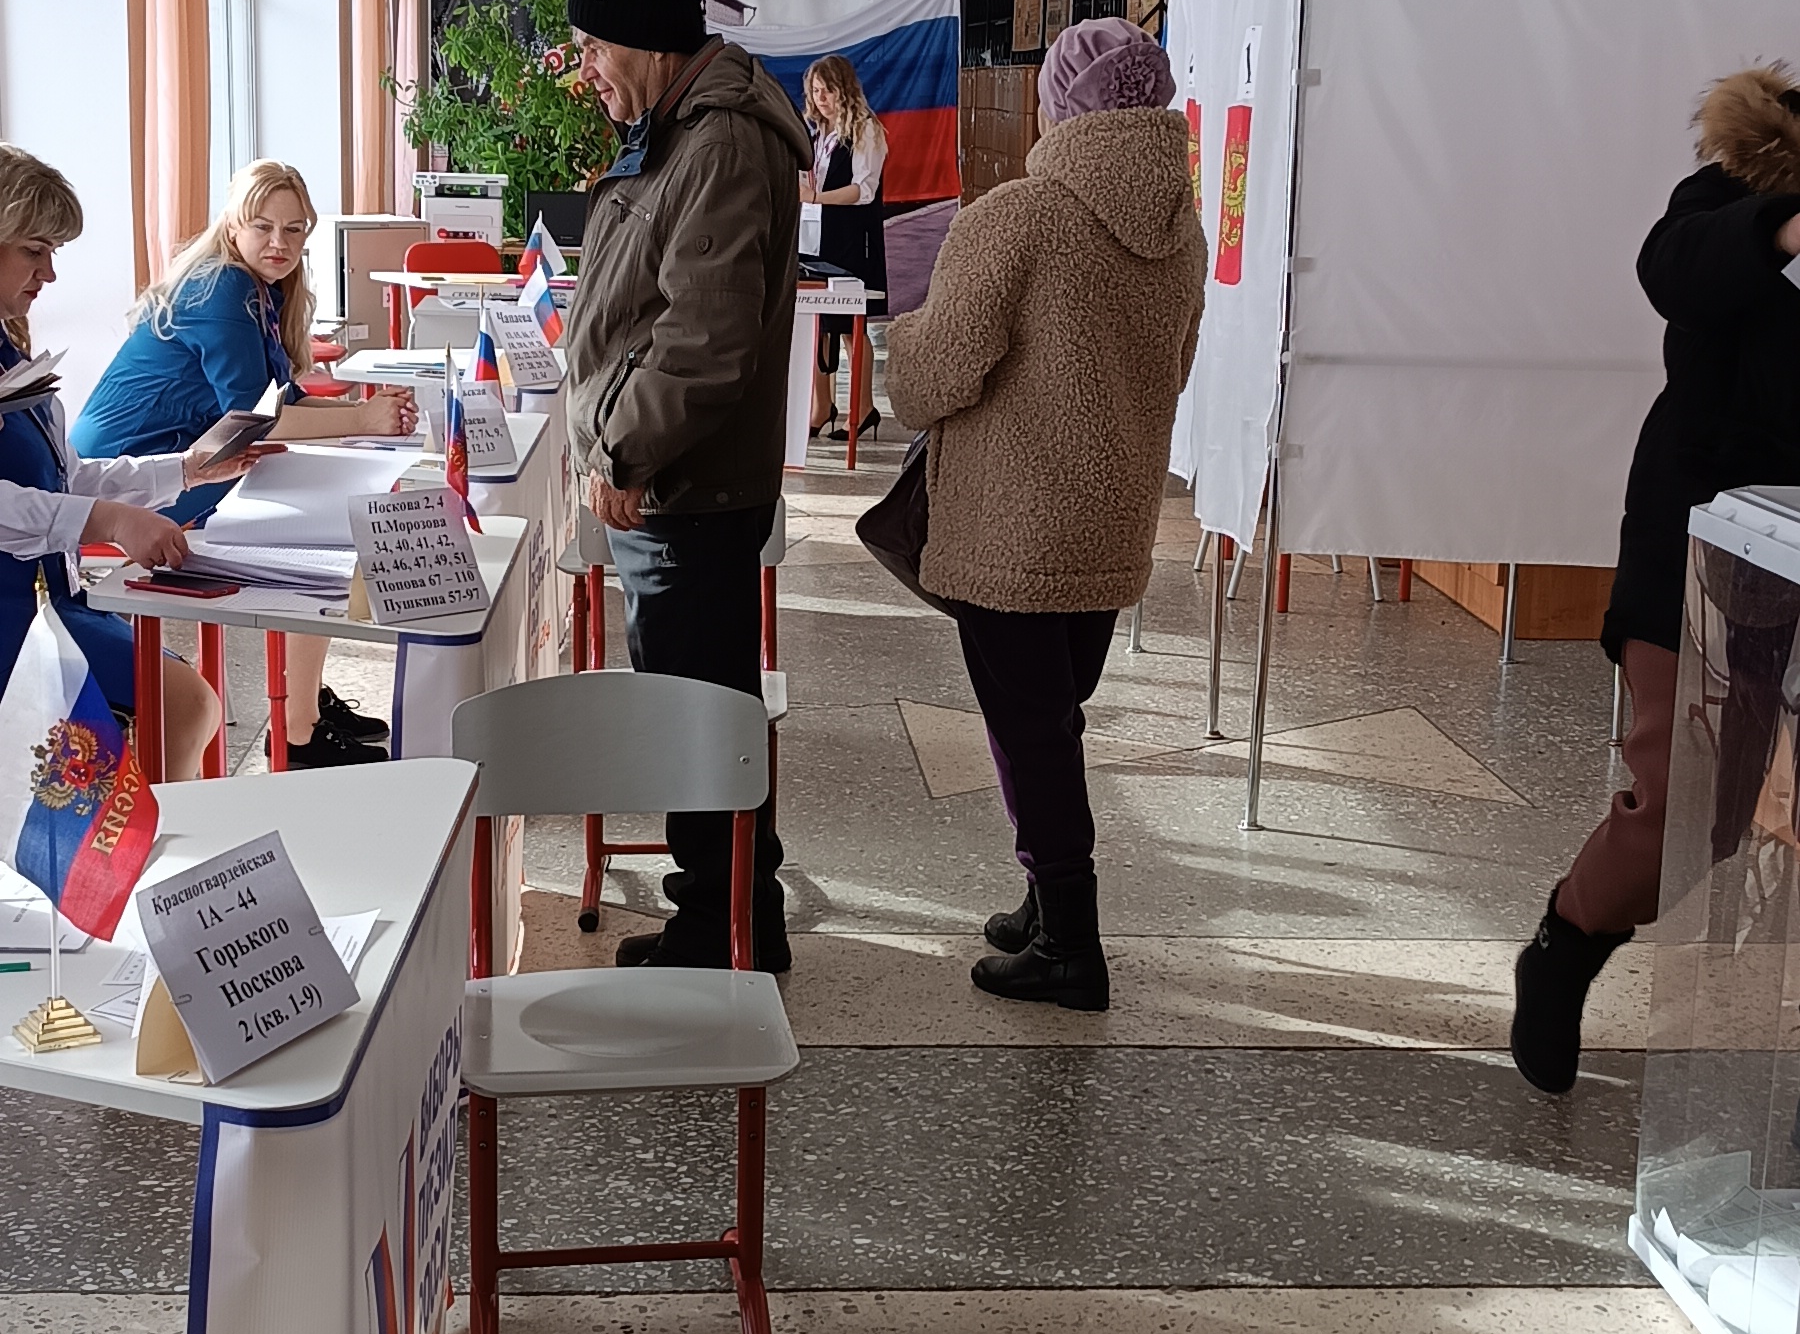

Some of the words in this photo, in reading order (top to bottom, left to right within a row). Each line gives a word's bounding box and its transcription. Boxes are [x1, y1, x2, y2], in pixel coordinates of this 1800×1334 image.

[368, 500, 420, 515] Носкова
[423, 496, 434, 511] 2,
[437, 495, 444, 508] 4
[371, 518, 447, 535] П.Морозова
[373, 540, 393, 555] 34,
[395, 538, 414, 554] 40,
[416, 536, 434, 550] 41,
[436, 534, 455, 548] 42,
[370, 561, 390, 575] 44,
[392, 558, 413, 572] 46,
[413, 556, 433, 570] 47,
[434, 553, 452, 567] 49,
[454, 552, 468, 565] 51
[375, 577, 426, 593] Попова
[428, 574, 442, 587] 67
[454, 571, 475, 583] 110
[383, 596, 446, 614] Пушкина
[448, 587, 480, 604] 57-97
[151, 849, 277, 916] Красногвардейская
[196, 904, 224, 930] 1А
[236, 886, 258, 911] 44
[193, 917, 291, 975] Горького
[218, 954, 306, 1009] Носкова
[238, 1020, 254, 1043] 2
[254, 1011, 290, 1039] (кв.
[287, 982, 323, 1017] 1-9)
